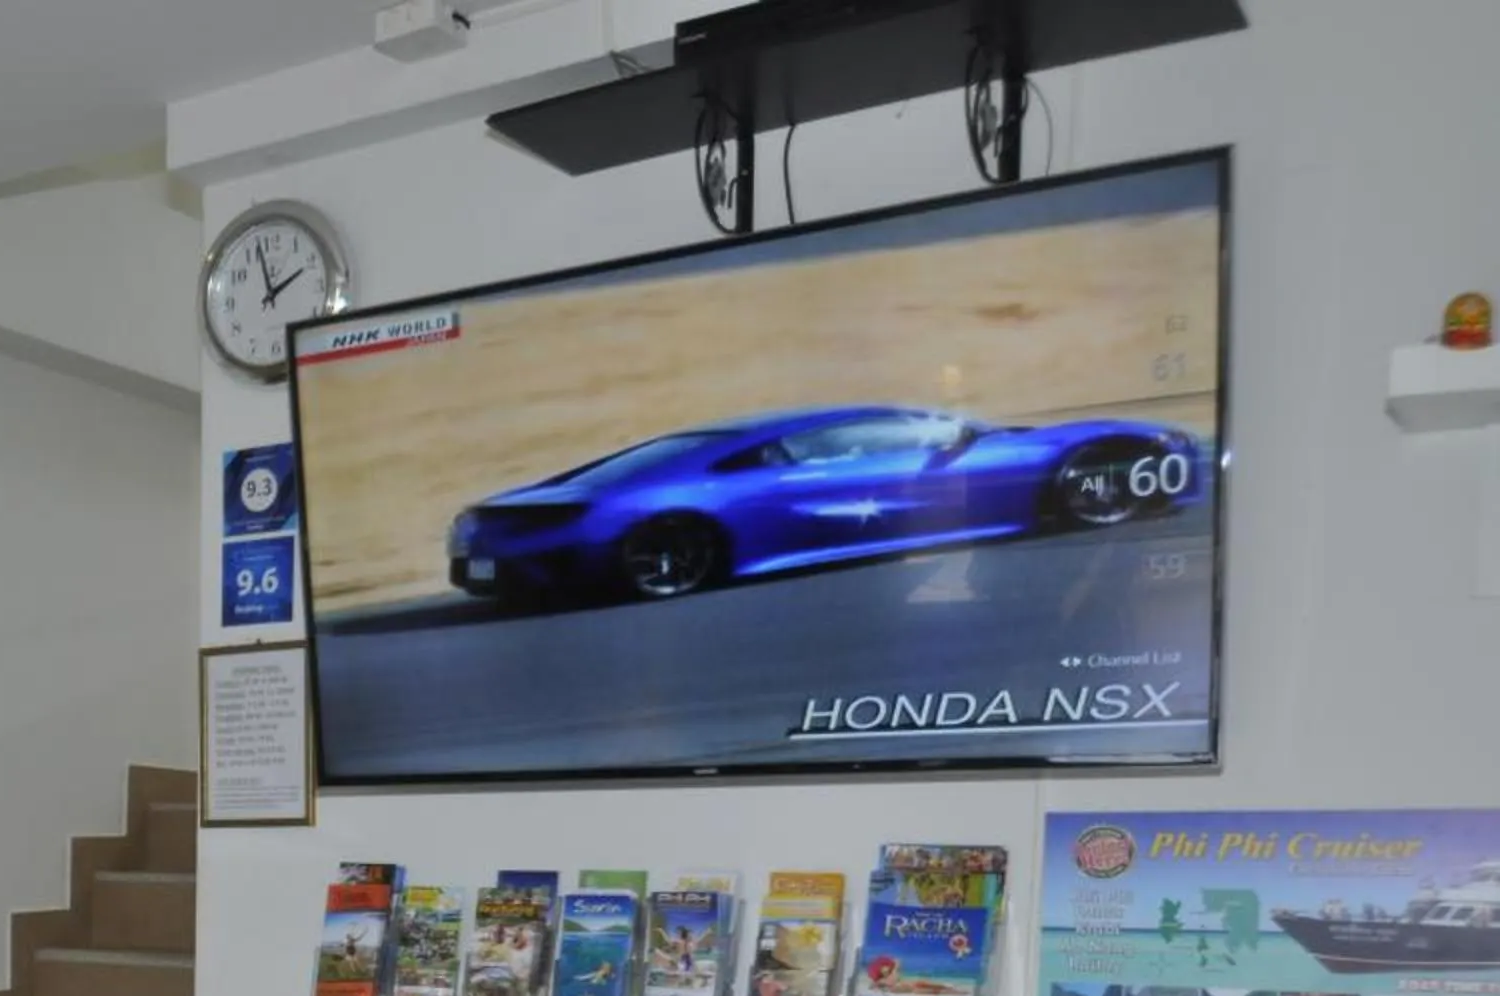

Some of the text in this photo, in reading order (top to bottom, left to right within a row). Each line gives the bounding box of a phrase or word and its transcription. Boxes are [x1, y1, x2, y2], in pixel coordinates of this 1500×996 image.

[332, 317, 448, 348] NHK WORLD
[246, 477, 273, 498] 9.3
[1129, 453, 1189, 497] 60
[236, 567, 279, 597] 9.6
[1147, 554, 1187, 580] 59
[1087, 652, 1149, 669] Channel
[802, 682, 1181, 731] HONDA NSX
[1149, 832, 1208, 861] Phi
[1217, 831, 1279, 862] Phi
[1287, 831, 1425, 861] Cruiser
[884, 914, 968, 938] RACHA
